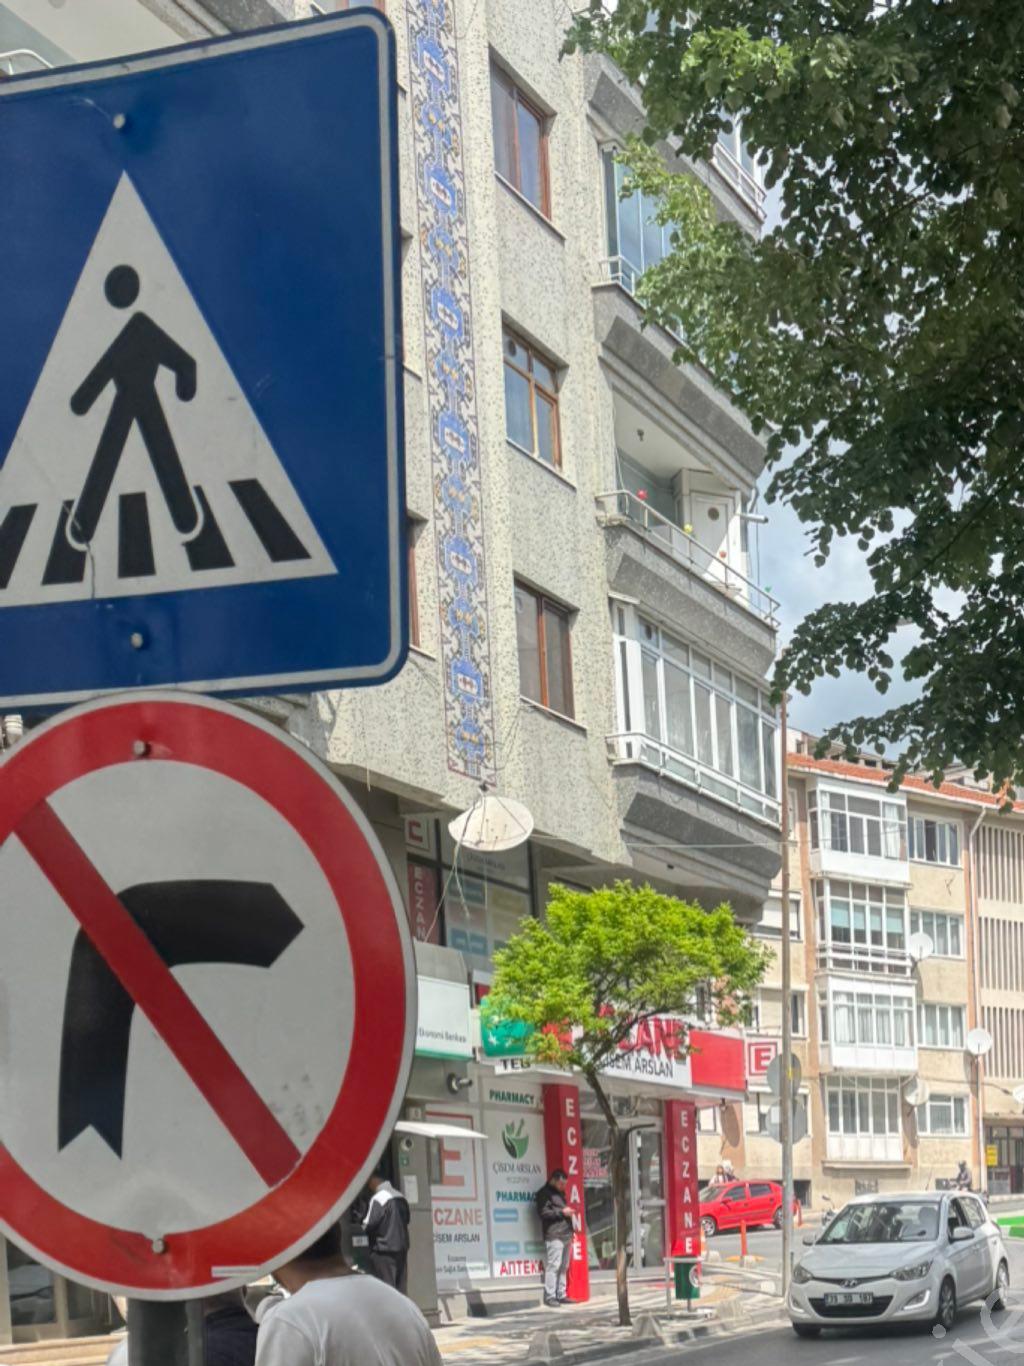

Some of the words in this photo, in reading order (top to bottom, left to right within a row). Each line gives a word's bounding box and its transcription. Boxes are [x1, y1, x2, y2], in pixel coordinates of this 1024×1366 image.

[414, 866, 427, 939] ECZAN
[634, 1057, 674, 1079] ARSLAN
[489, 1089, 535, 1105] PHARMACY
[565, 1098, 582, 1261] ECZANE
[681, 1111, 693, 1254] ECZANE
[495, 1190, 537, 1202] PHARMAC
[433, 1207, 483, 1226] CZANE
